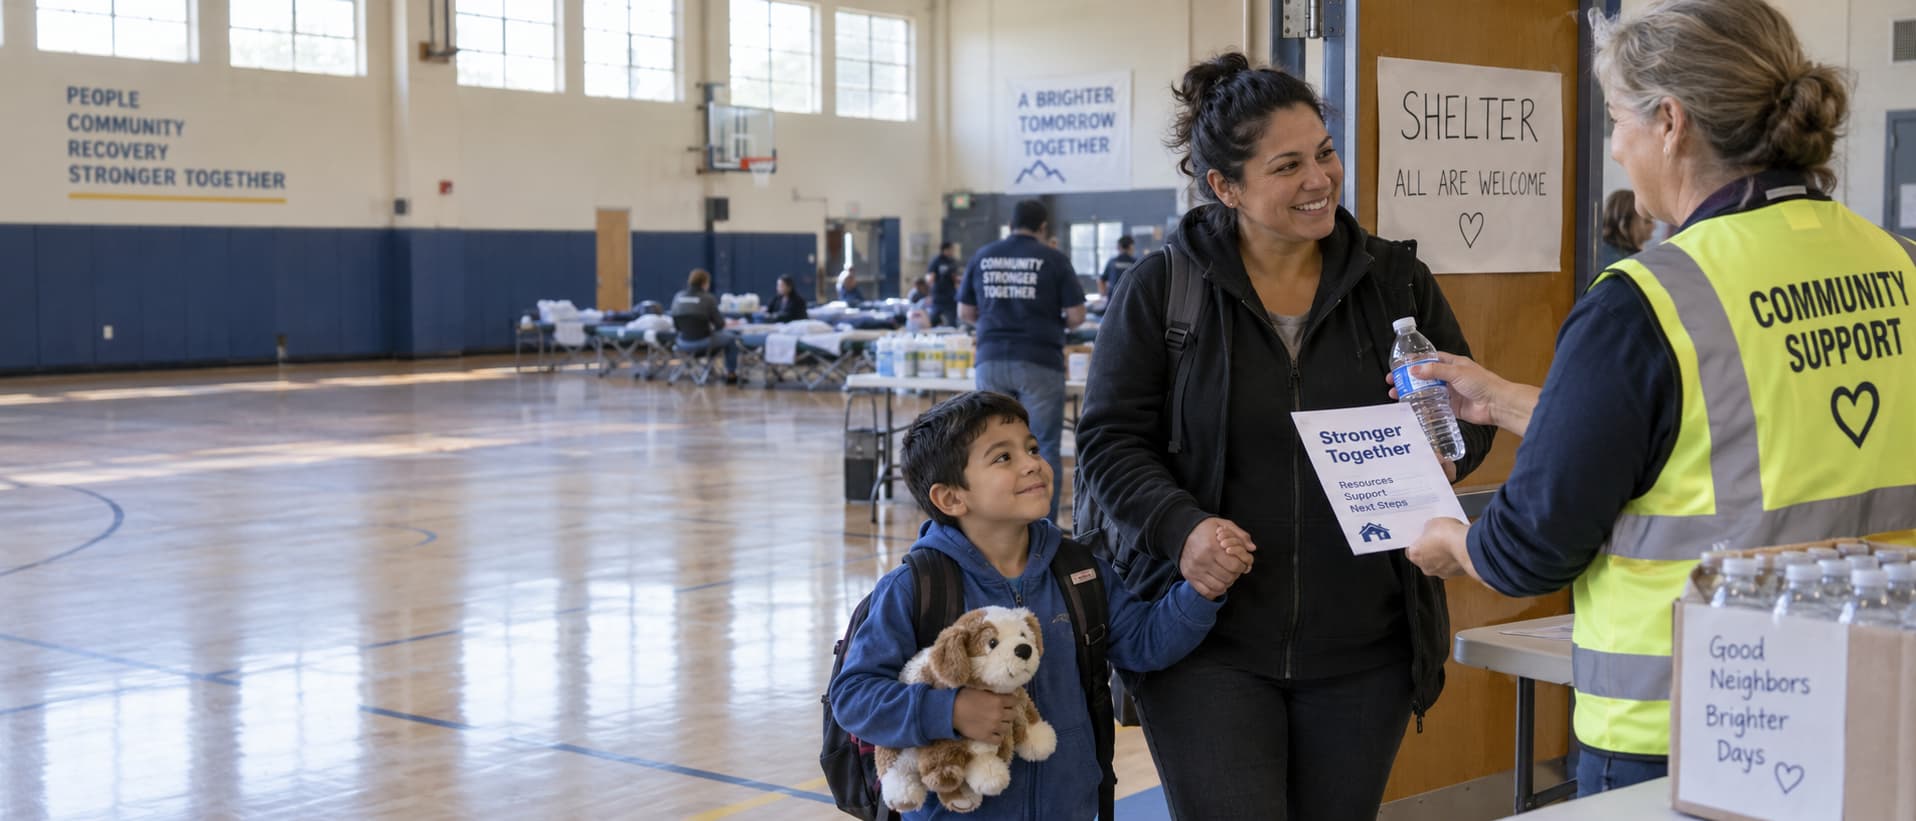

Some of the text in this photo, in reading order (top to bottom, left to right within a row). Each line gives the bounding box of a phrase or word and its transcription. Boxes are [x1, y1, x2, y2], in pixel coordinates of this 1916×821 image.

[66, 86, 139, 108] PEOPLE
[1018, 86, 1115, 108] A BRIGHTER
[67, 113, 184, 136] COMMUNITY
[1019, 112, 1116, 132] TOMORROW
[1401, 90, 1538, 142] SHELTER
[68, 139, 168, 160] RECOVERY
[1024, 136, 1110, 156] TOGETHER
[69, 165, 286, 189] STRONGER TOGETHER
[1394, 168, 1547, 197] ALL ARE WELCOME
[981, 257, 1044, 271] COMMUNITY
[983, 271, 1037, 285] STRONGER
[984, 285, 1036, 299] TOGETHER
[1749, 271, 1909, 328] COMMUNITY
[1785, 317, 1902, 373] SUPPORT
[1319, 424, 1402, 445] Stronger
[1326, 442, 1411, 464] Together
[1339, 477, 1394, 489] Resources
[1344, 489, 1387, 501] Support
[1350, 499, 1408, 512] Next Steps
[1710, 635, 1765, 662] Good
[1710, 668, 1811, 700] Neighbors
[1706, 704, 1789, 738] Brighter
[1717, 739, 1765, 774] Days
